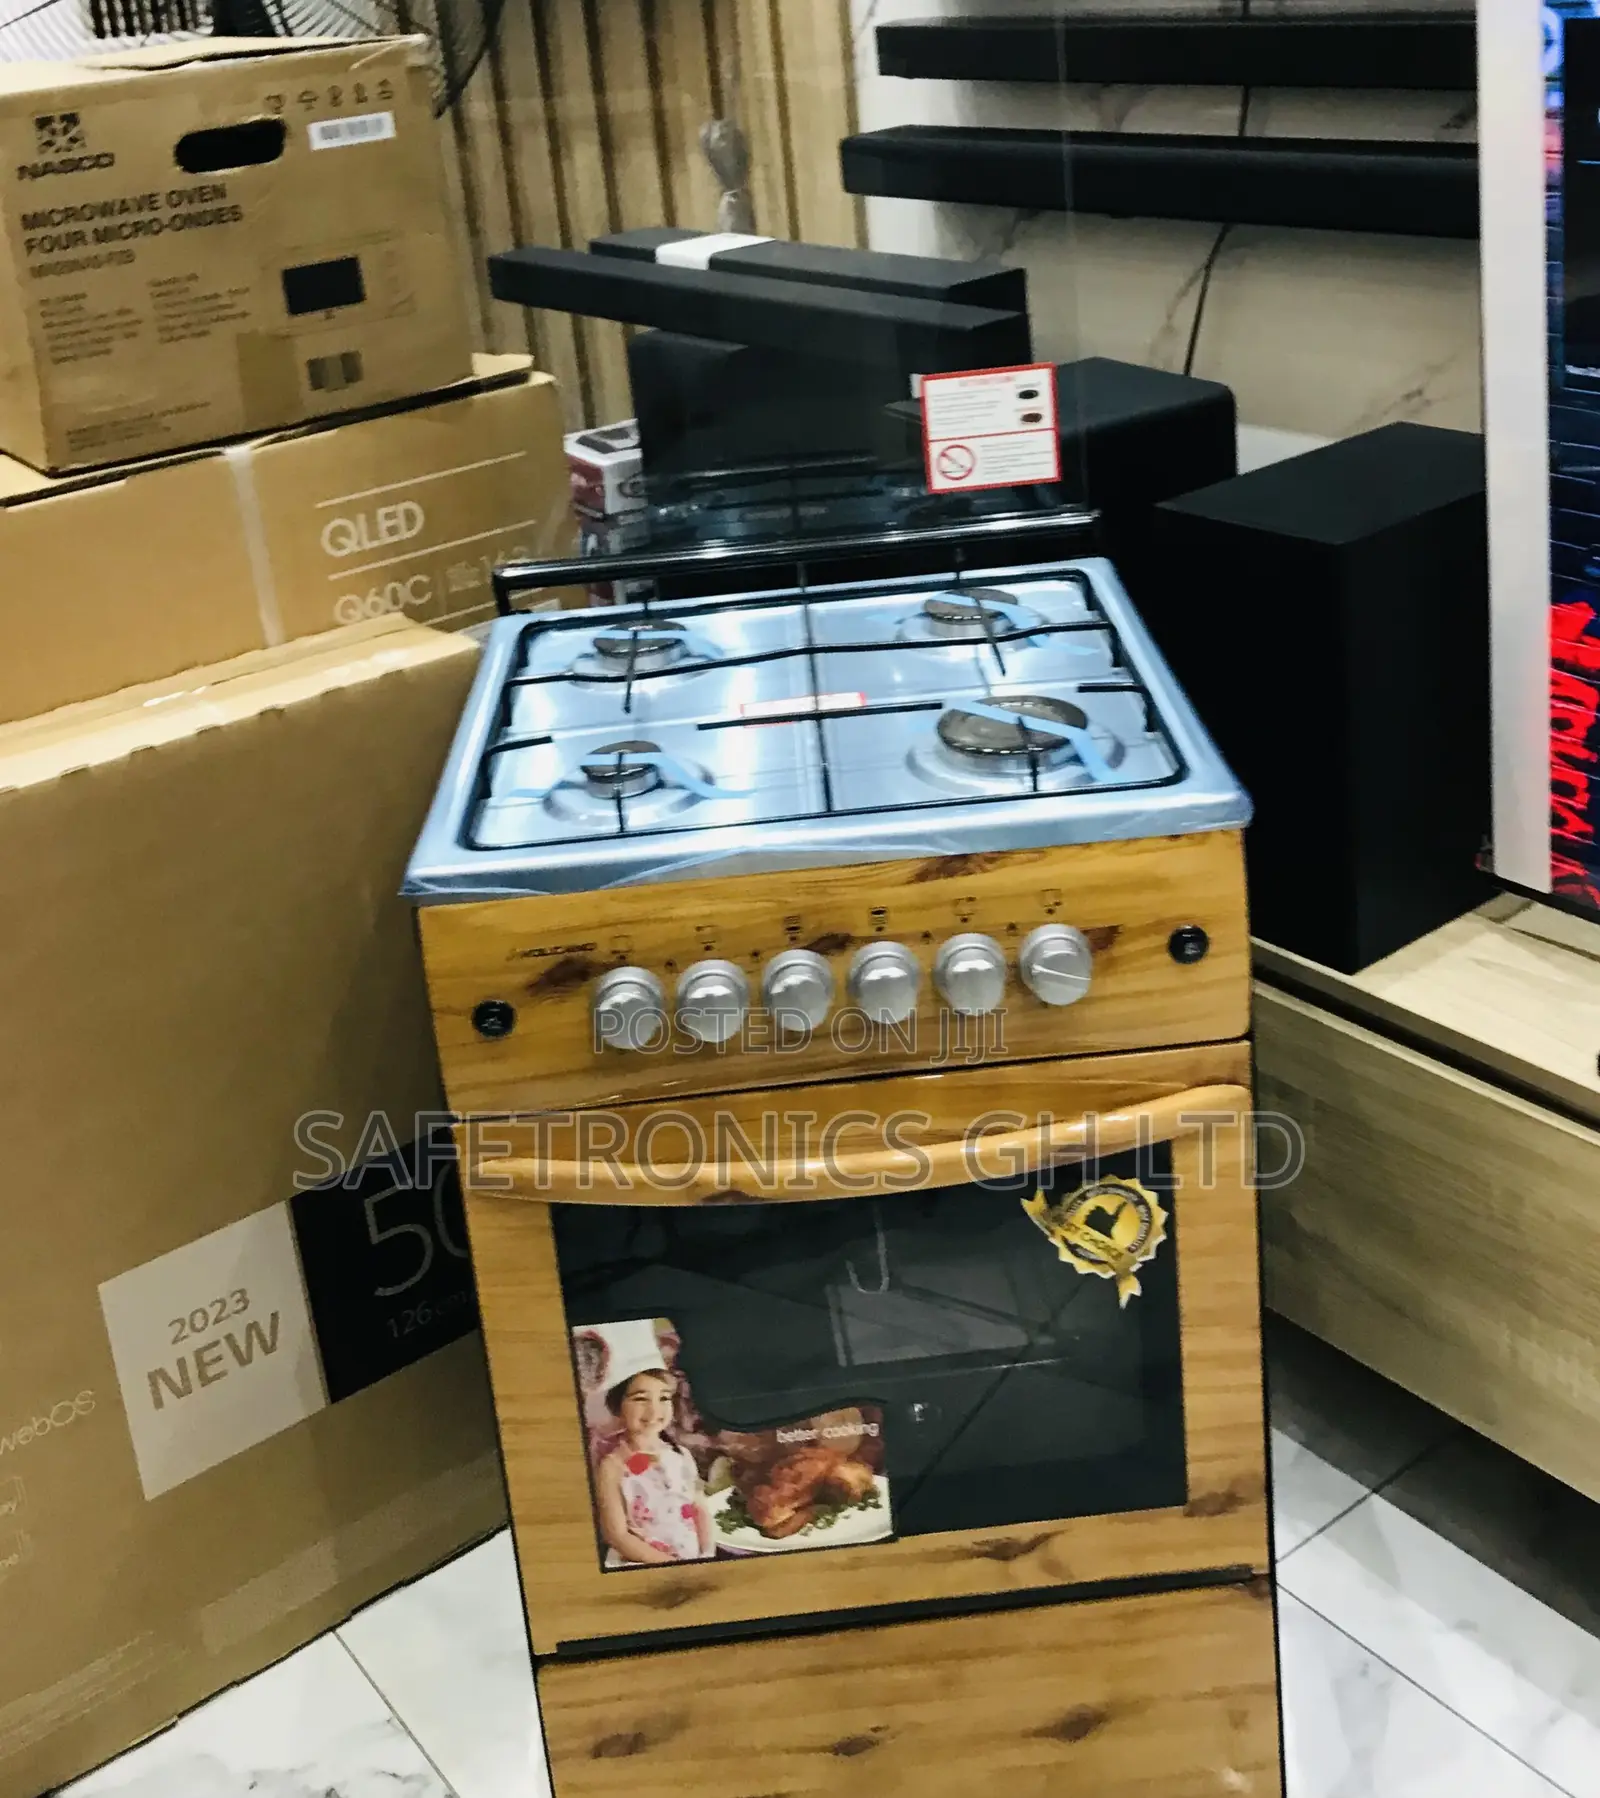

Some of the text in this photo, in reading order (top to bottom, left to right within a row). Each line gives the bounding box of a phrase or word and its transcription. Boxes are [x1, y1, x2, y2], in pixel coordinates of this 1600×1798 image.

[21, 183, 227, 230] MICROWAVE OVEN
[24, 204, 244, 257] FOUR MICRO-ONDES
[320, 500, 424, 557] QLED
[333, 574, 432, 625] Q60C
[168, 1287, 250, 1345] 2023
[146, 1310, 281, 1410] NEW
[776, 1421, 880, 1444] better cooking
